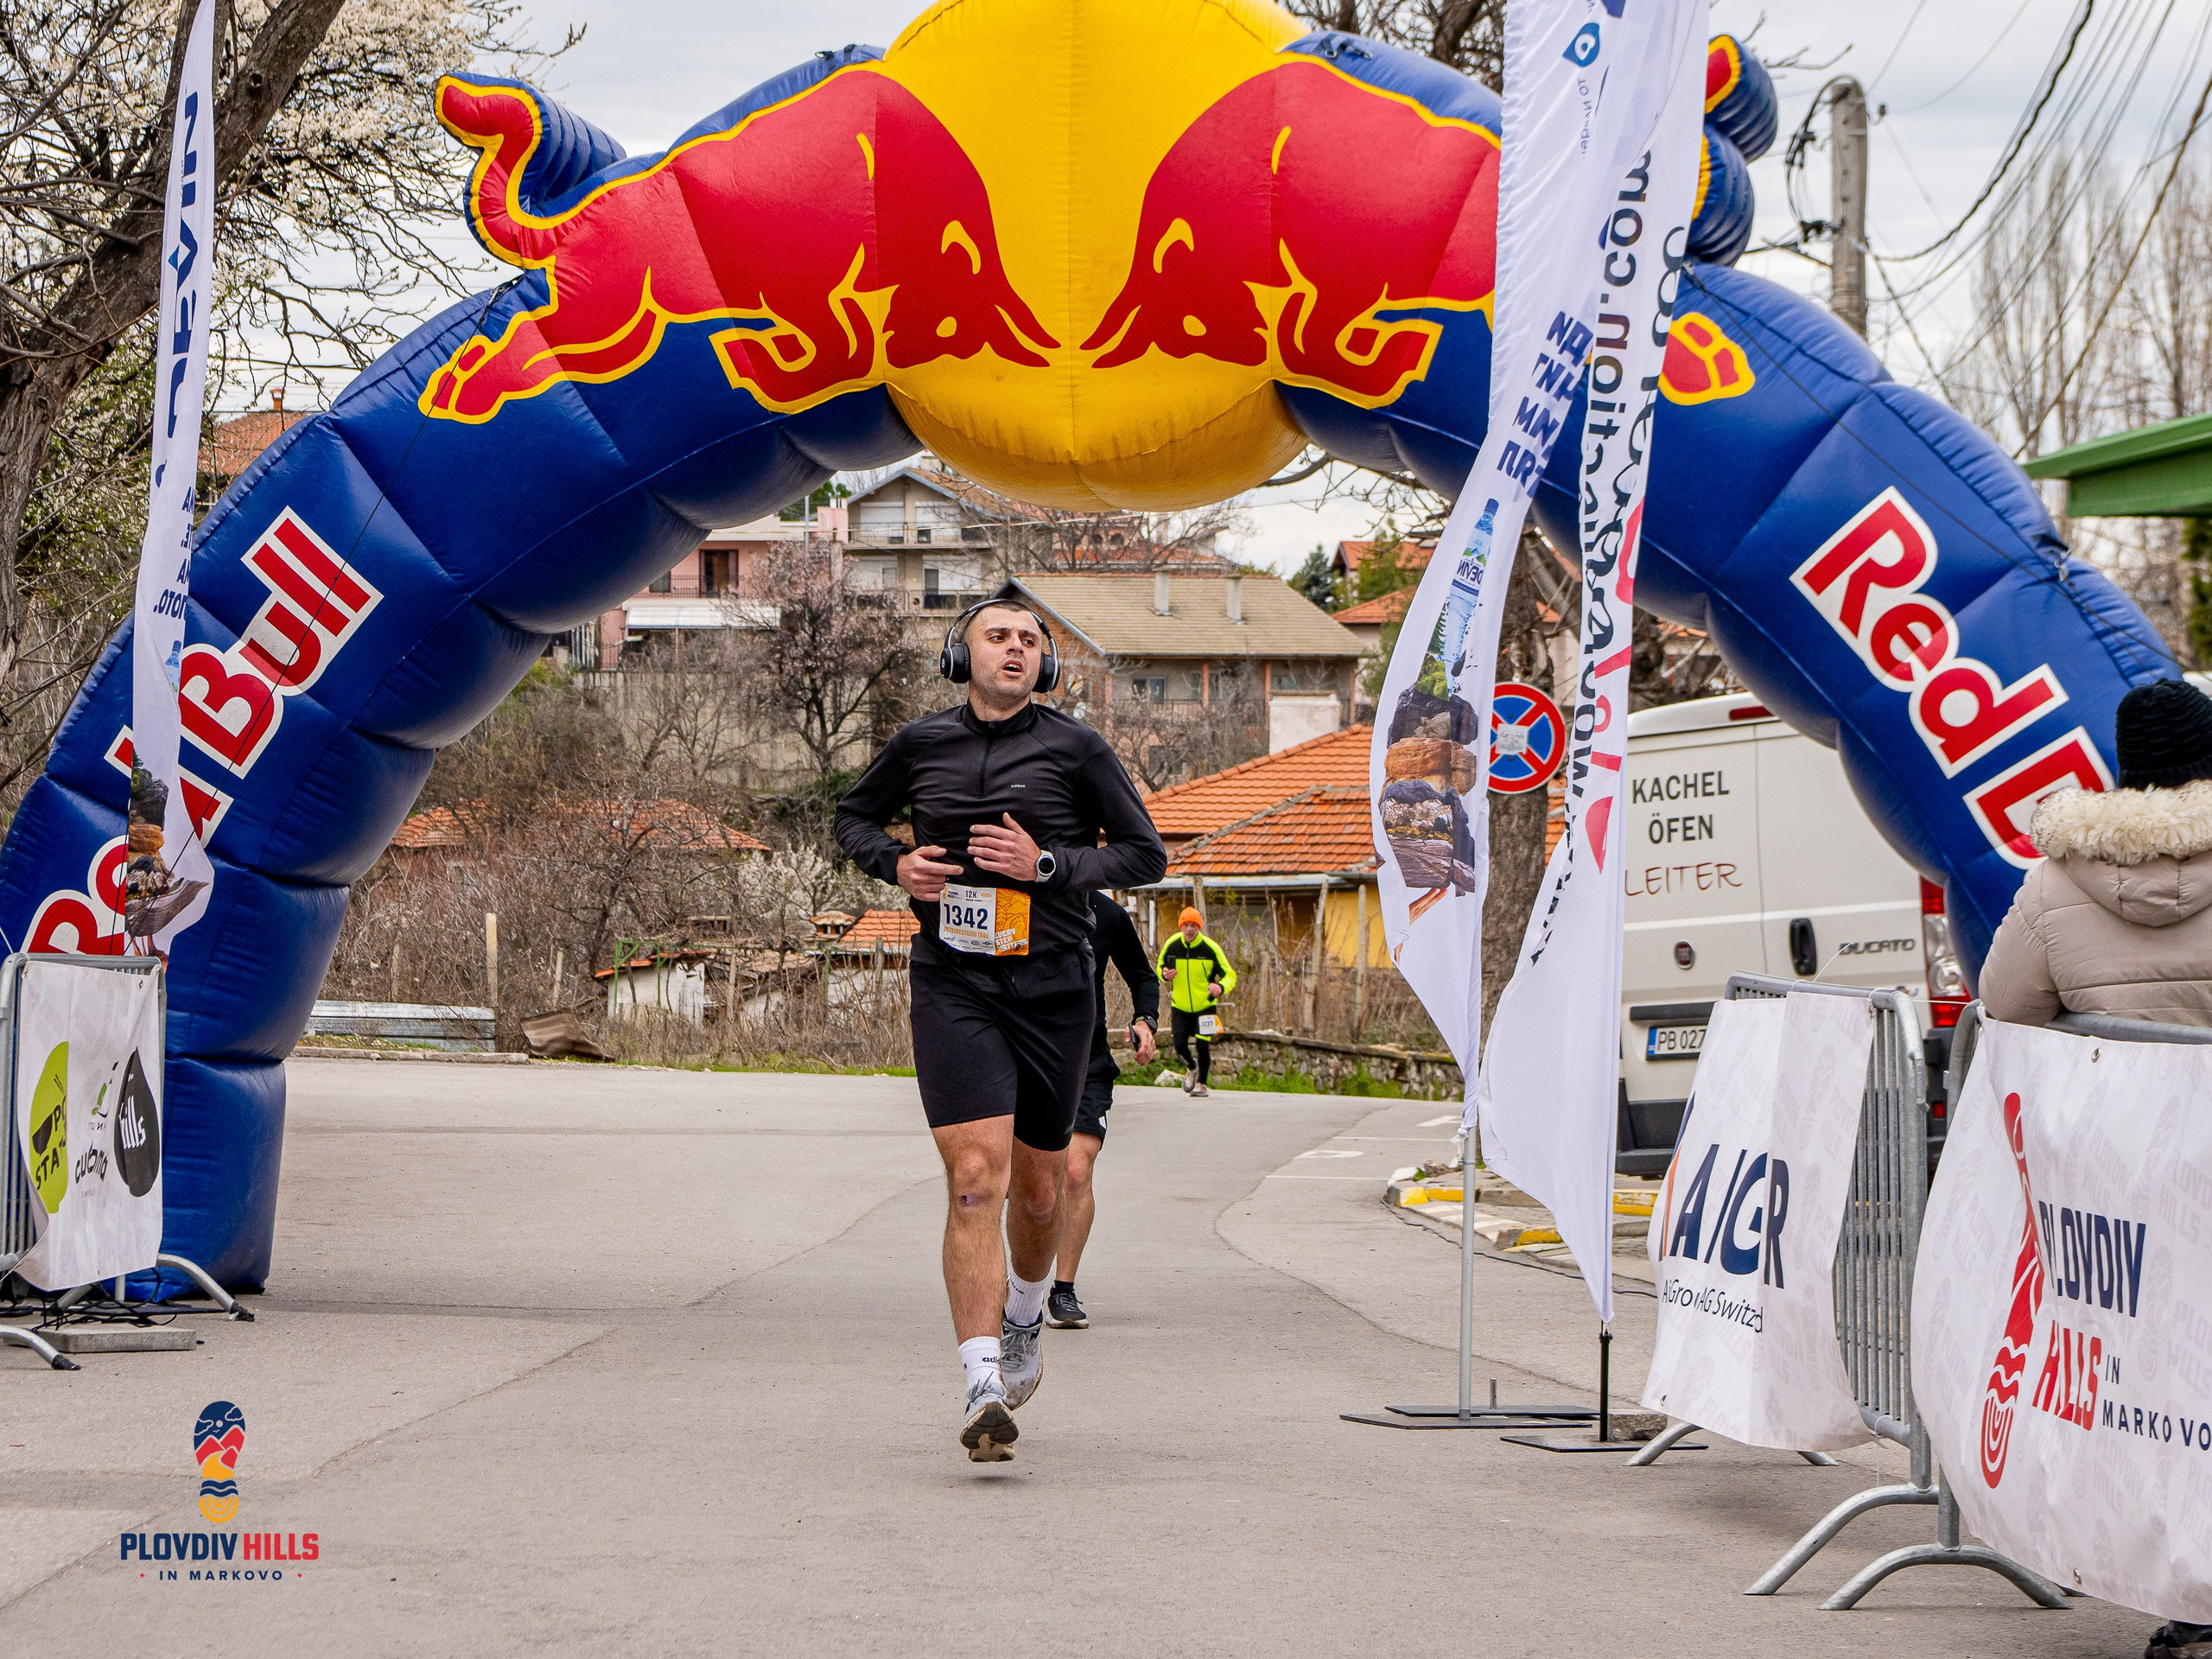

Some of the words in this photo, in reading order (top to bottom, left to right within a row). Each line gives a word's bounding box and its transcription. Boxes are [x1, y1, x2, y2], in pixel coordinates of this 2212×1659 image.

[1796, 492, 2063, 772] Red
[23, 728, 228, 955] Re
[181, 510, 378, 774] Bull
[1631, 770, 1730, 804] KACHEL
[1648, 812, 1713, 845] ÖFEN
[965, 890, 977, 899] 12K
[1624, 862, 1743, 897] LEITER
[944, 903, 988, 931] 1342
[1839, 938, 1916, 956] DUCATO
[1657, 1031, 1676, 1051] PB
[1680, 1028, 1707, 1049] 027
[2038, 1199, 2146, 1319] PLOVDIV
[2105, 1353, 2120, 1385] IN
